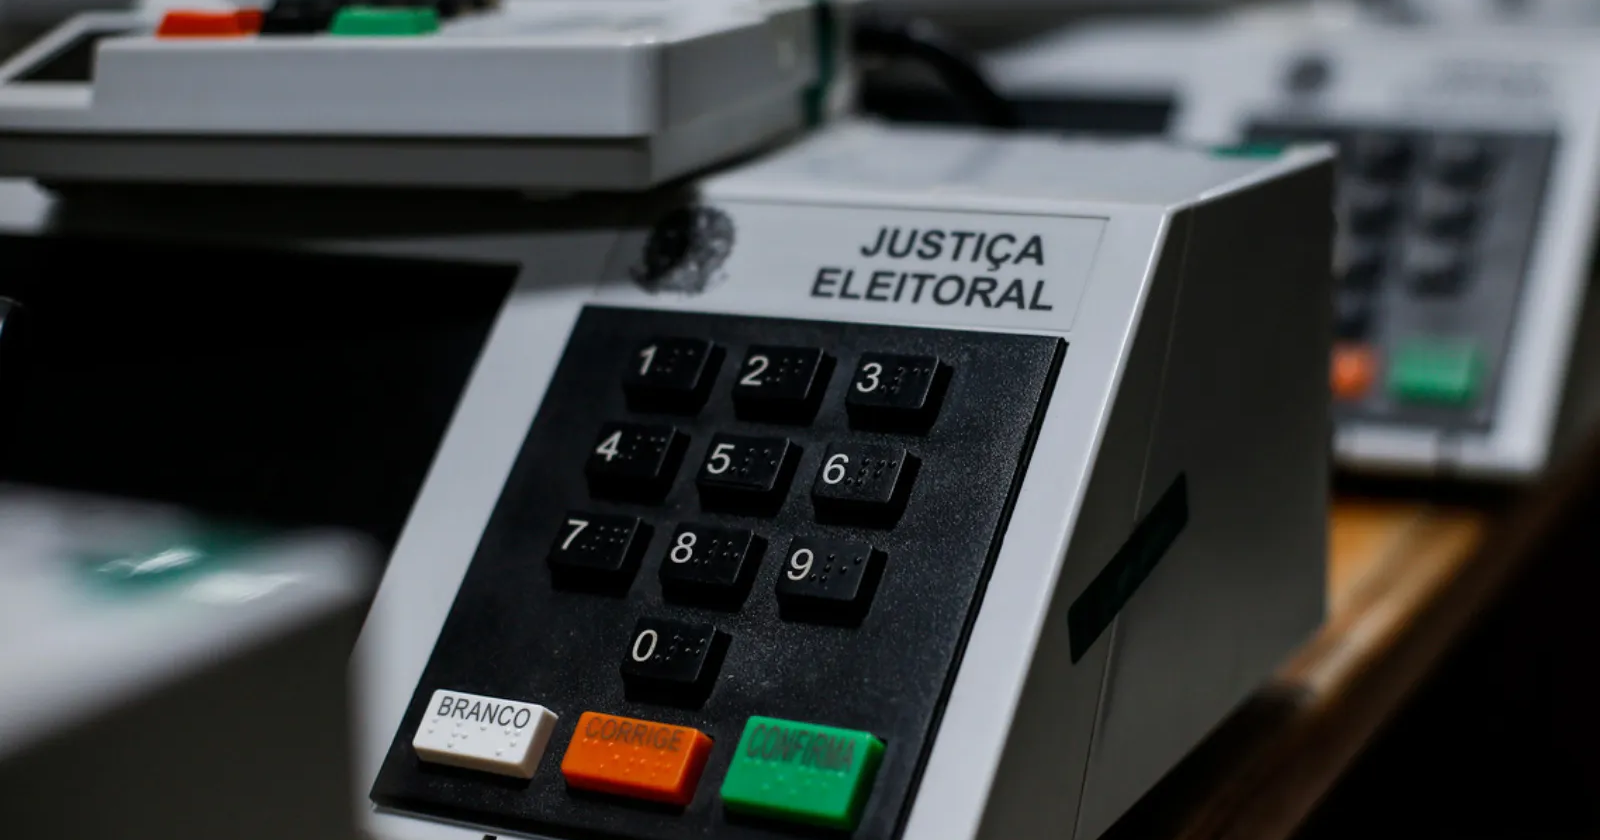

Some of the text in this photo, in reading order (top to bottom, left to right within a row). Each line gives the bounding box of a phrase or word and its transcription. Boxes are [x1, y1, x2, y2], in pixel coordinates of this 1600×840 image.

[860, 227, 1045, 271] JUSTIÇA
[810, 266, 1053, 311] ELEITORAL
[638, 346, 658, 375] 1
[740, 355, 769, 386] 2
[856, 362, 883, 393] 3
[595, 430, 623, 461] 4
[706, 443, 735, 474] 5
[822, 453, 849, 485] 6
[559, 519, 589, 551] 7
[670, 531, 697, 564] 8
[787, 548, 814, 581] 9
[632, 629, 658, 662] 0
[437, 695, 531, 729] BRANCO
[585, 717, 685, 751] CORRIGE
[746, 722, 856, 773] CONFIRMA
